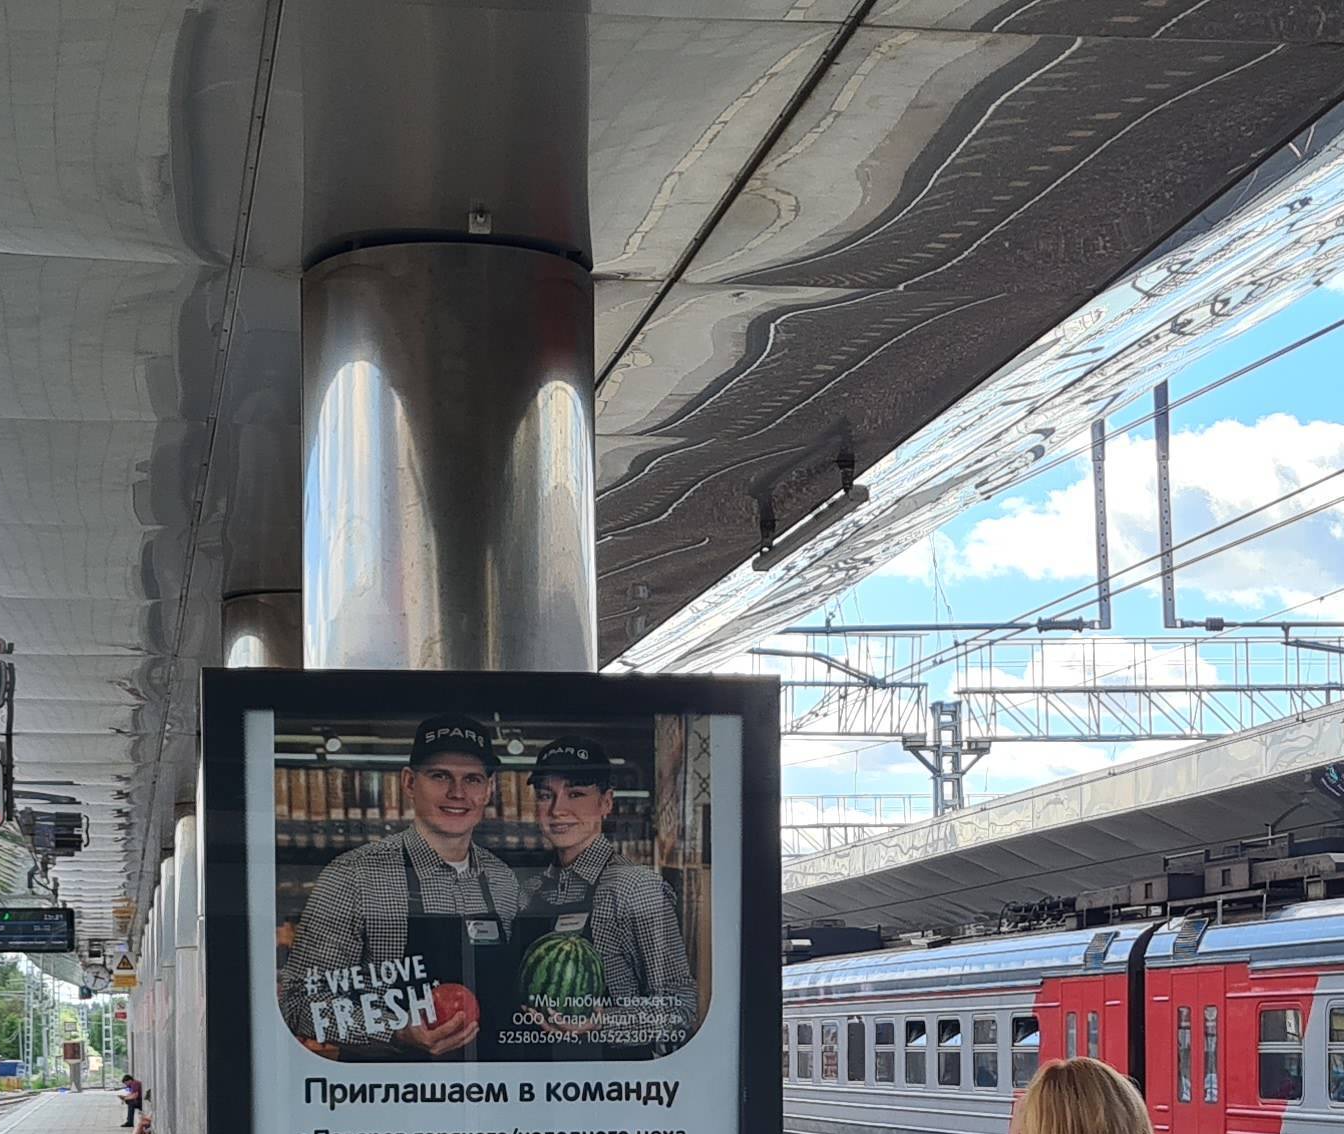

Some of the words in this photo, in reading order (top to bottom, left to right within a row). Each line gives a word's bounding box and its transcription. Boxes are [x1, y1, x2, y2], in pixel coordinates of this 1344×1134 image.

[424, 727, 480, 744] SPAR
[368, 955, 428, 989] LOVE
[563, 993, 612, 1008] любим
[512, 1012, 544, 1025] ООО
[547, 1012, 587, 1027] «Спар
[498, 1031, 582, 1045] 5258056945,
[304, 1077, 509, 1111] Приглашаем
[519, 1082, 536, 1103] в
[545, 1080, 680, 1108] команду
